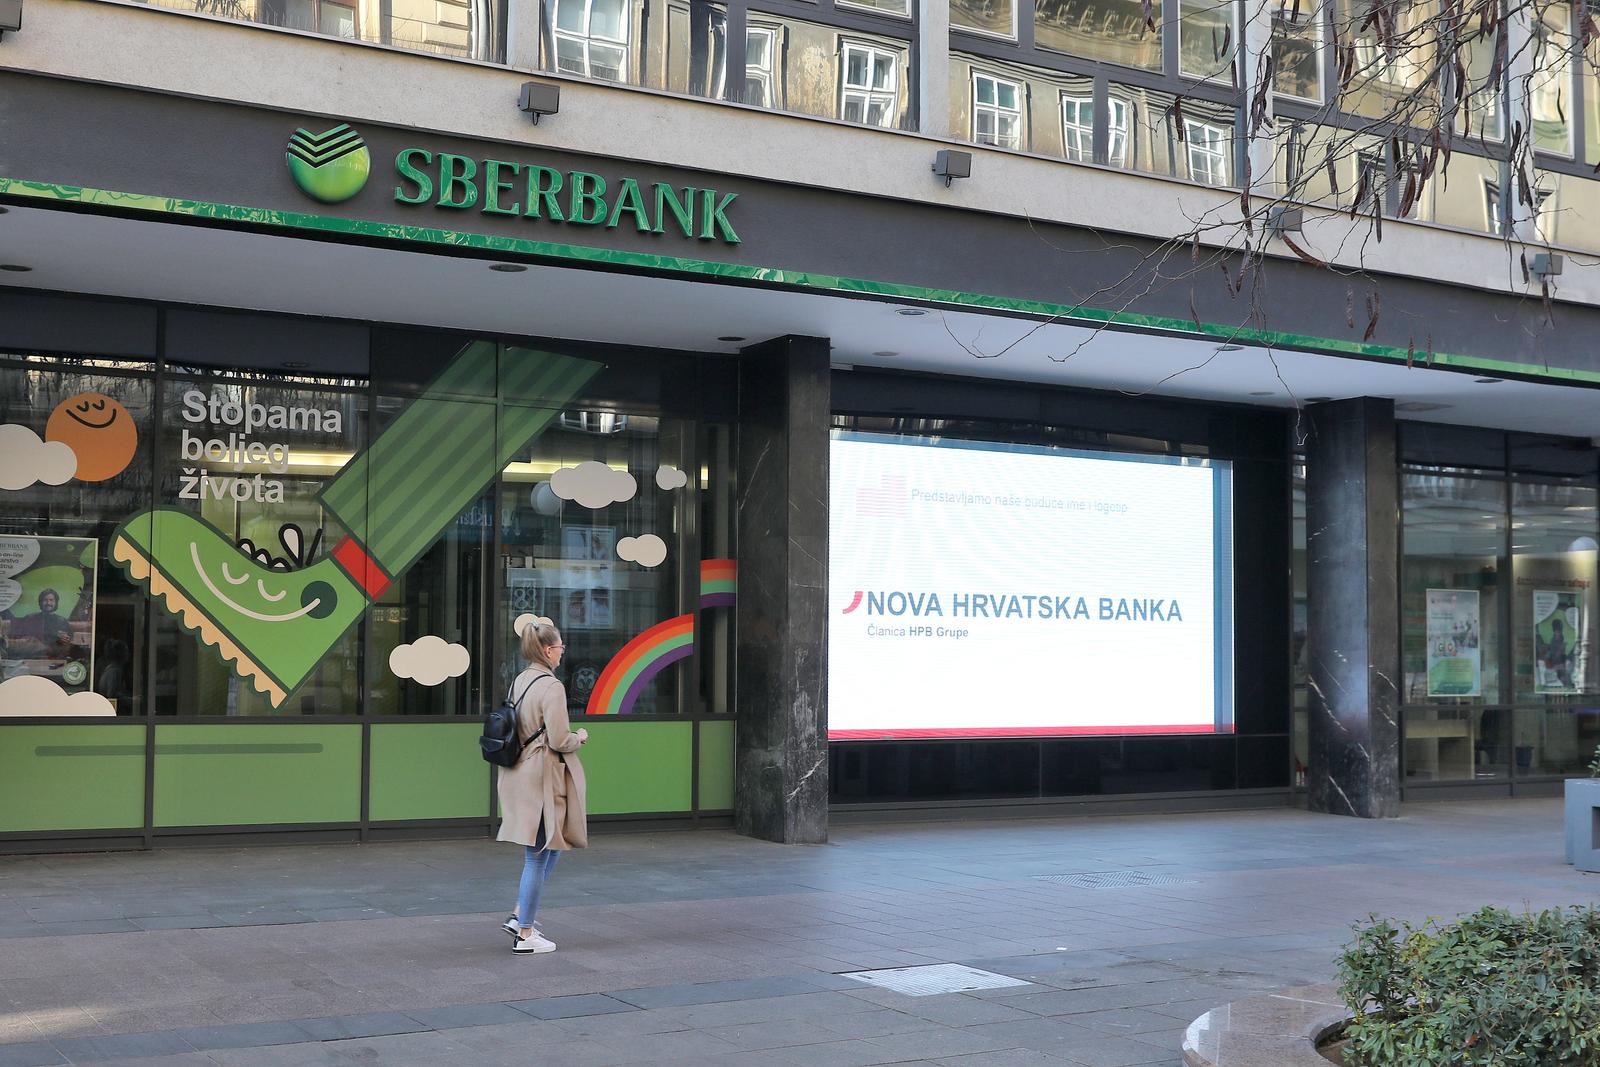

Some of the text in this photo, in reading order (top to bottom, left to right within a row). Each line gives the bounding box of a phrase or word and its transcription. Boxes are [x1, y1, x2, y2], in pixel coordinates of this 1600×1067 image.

[394, 148, 741, 244] SBERBANK
[182, 390, 342, 434] Stopama
[181, 429, 289, 475] boljeg
[178, 467, 285, 504] života
[911, 488, 992, 506] Predstavljamo
[867, 591, 1183, 622] NOVA HRVATSKA BANKA
[867, 623, 969, 640] Članica HPB Grupe
